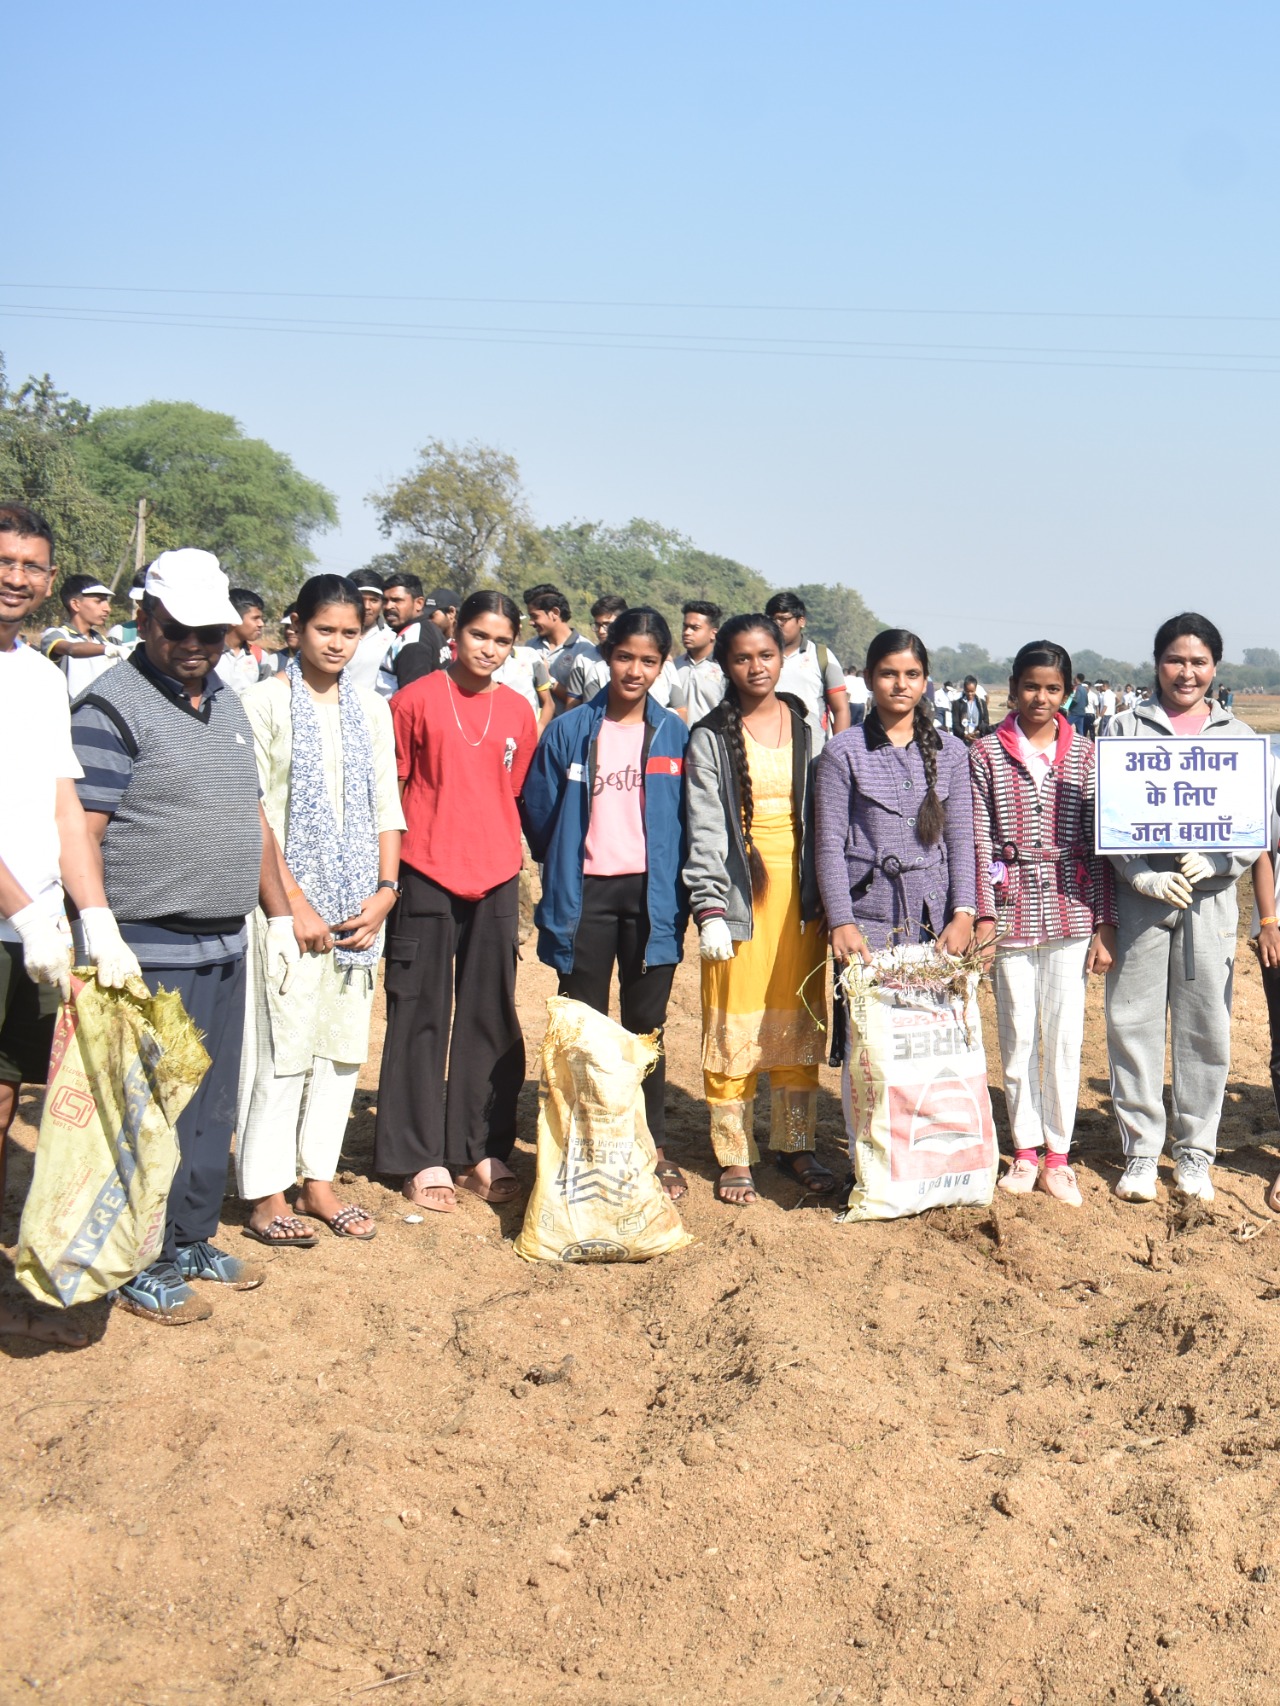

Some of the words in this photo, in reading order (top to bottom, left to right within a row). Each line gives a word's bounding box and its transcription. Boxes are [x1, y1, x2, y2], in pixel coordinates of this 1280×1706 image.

[1125, 746, 1172, 772] अच्छे
[1179, 746, 1238, 771] जीवन
[1145, 781, 1167, 806] के
[1173, 781, 1217, 806] लिए
[1131, 822, 1172, 842] जल
[49, 1003, 76, 1069] NCRETE
[893, 1025, 980, 1060] SHREE
[569, 1147, 633, 1165] AJESTI
